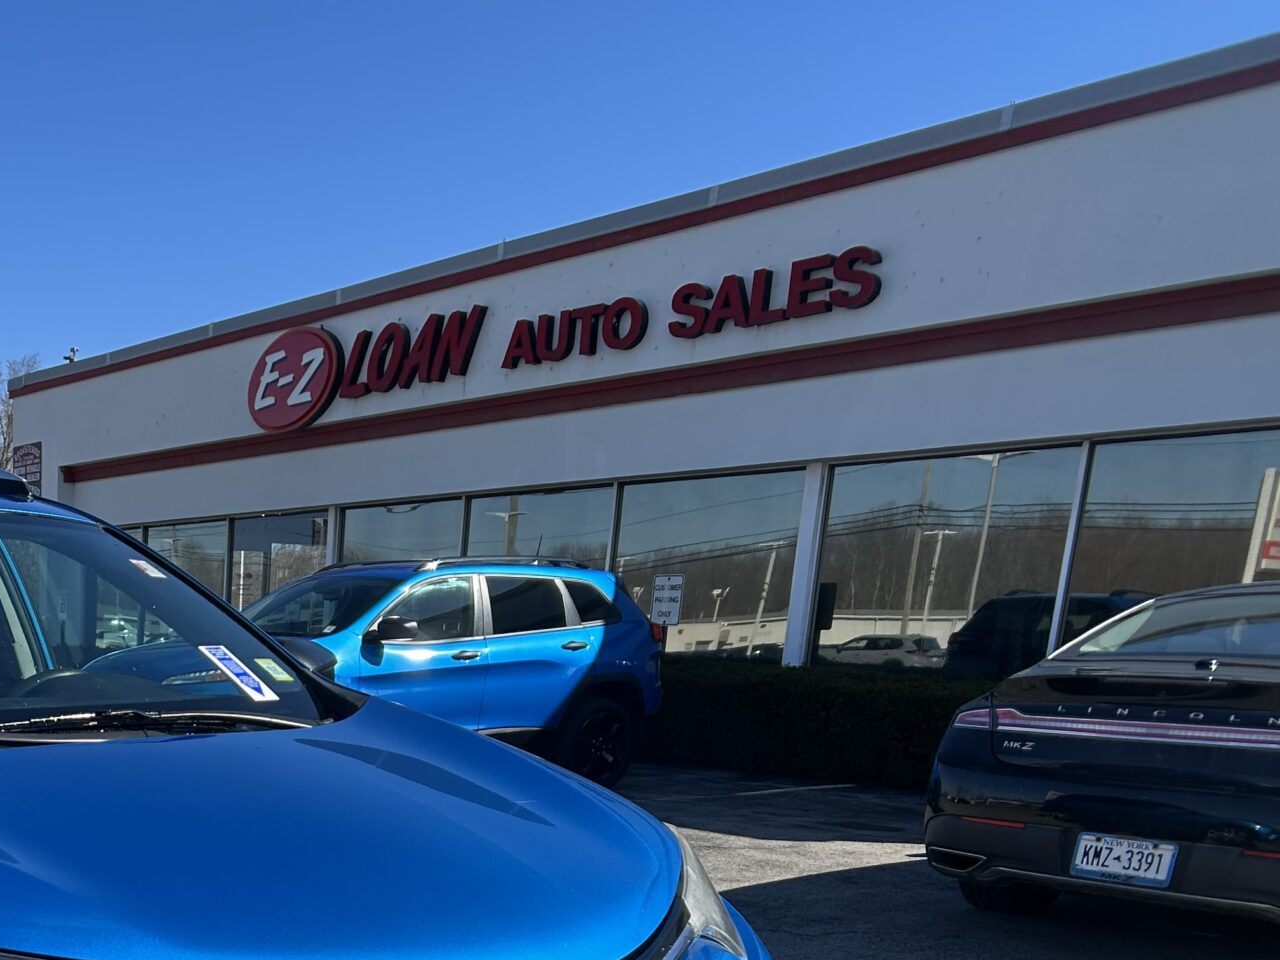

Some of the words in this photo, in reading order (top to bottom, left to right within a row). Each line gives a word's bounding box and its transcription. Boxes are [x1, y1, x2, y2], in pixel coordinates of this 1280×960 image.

[254, 347, 325, 411] E-Z
[339, 304, 488, 398] LOAN
[501, 296, 648, 370] AUTO
[668, 245, 883, 339] SALES
[658, 610, 671, 618] ONLY
[1057, 704, 1280, 725] LINCOLN
[1003, 739, 1035, 751] MKZ
[1103, 838, 1124, 848] NEW
[1126, 840, 1151, 851] YORK
